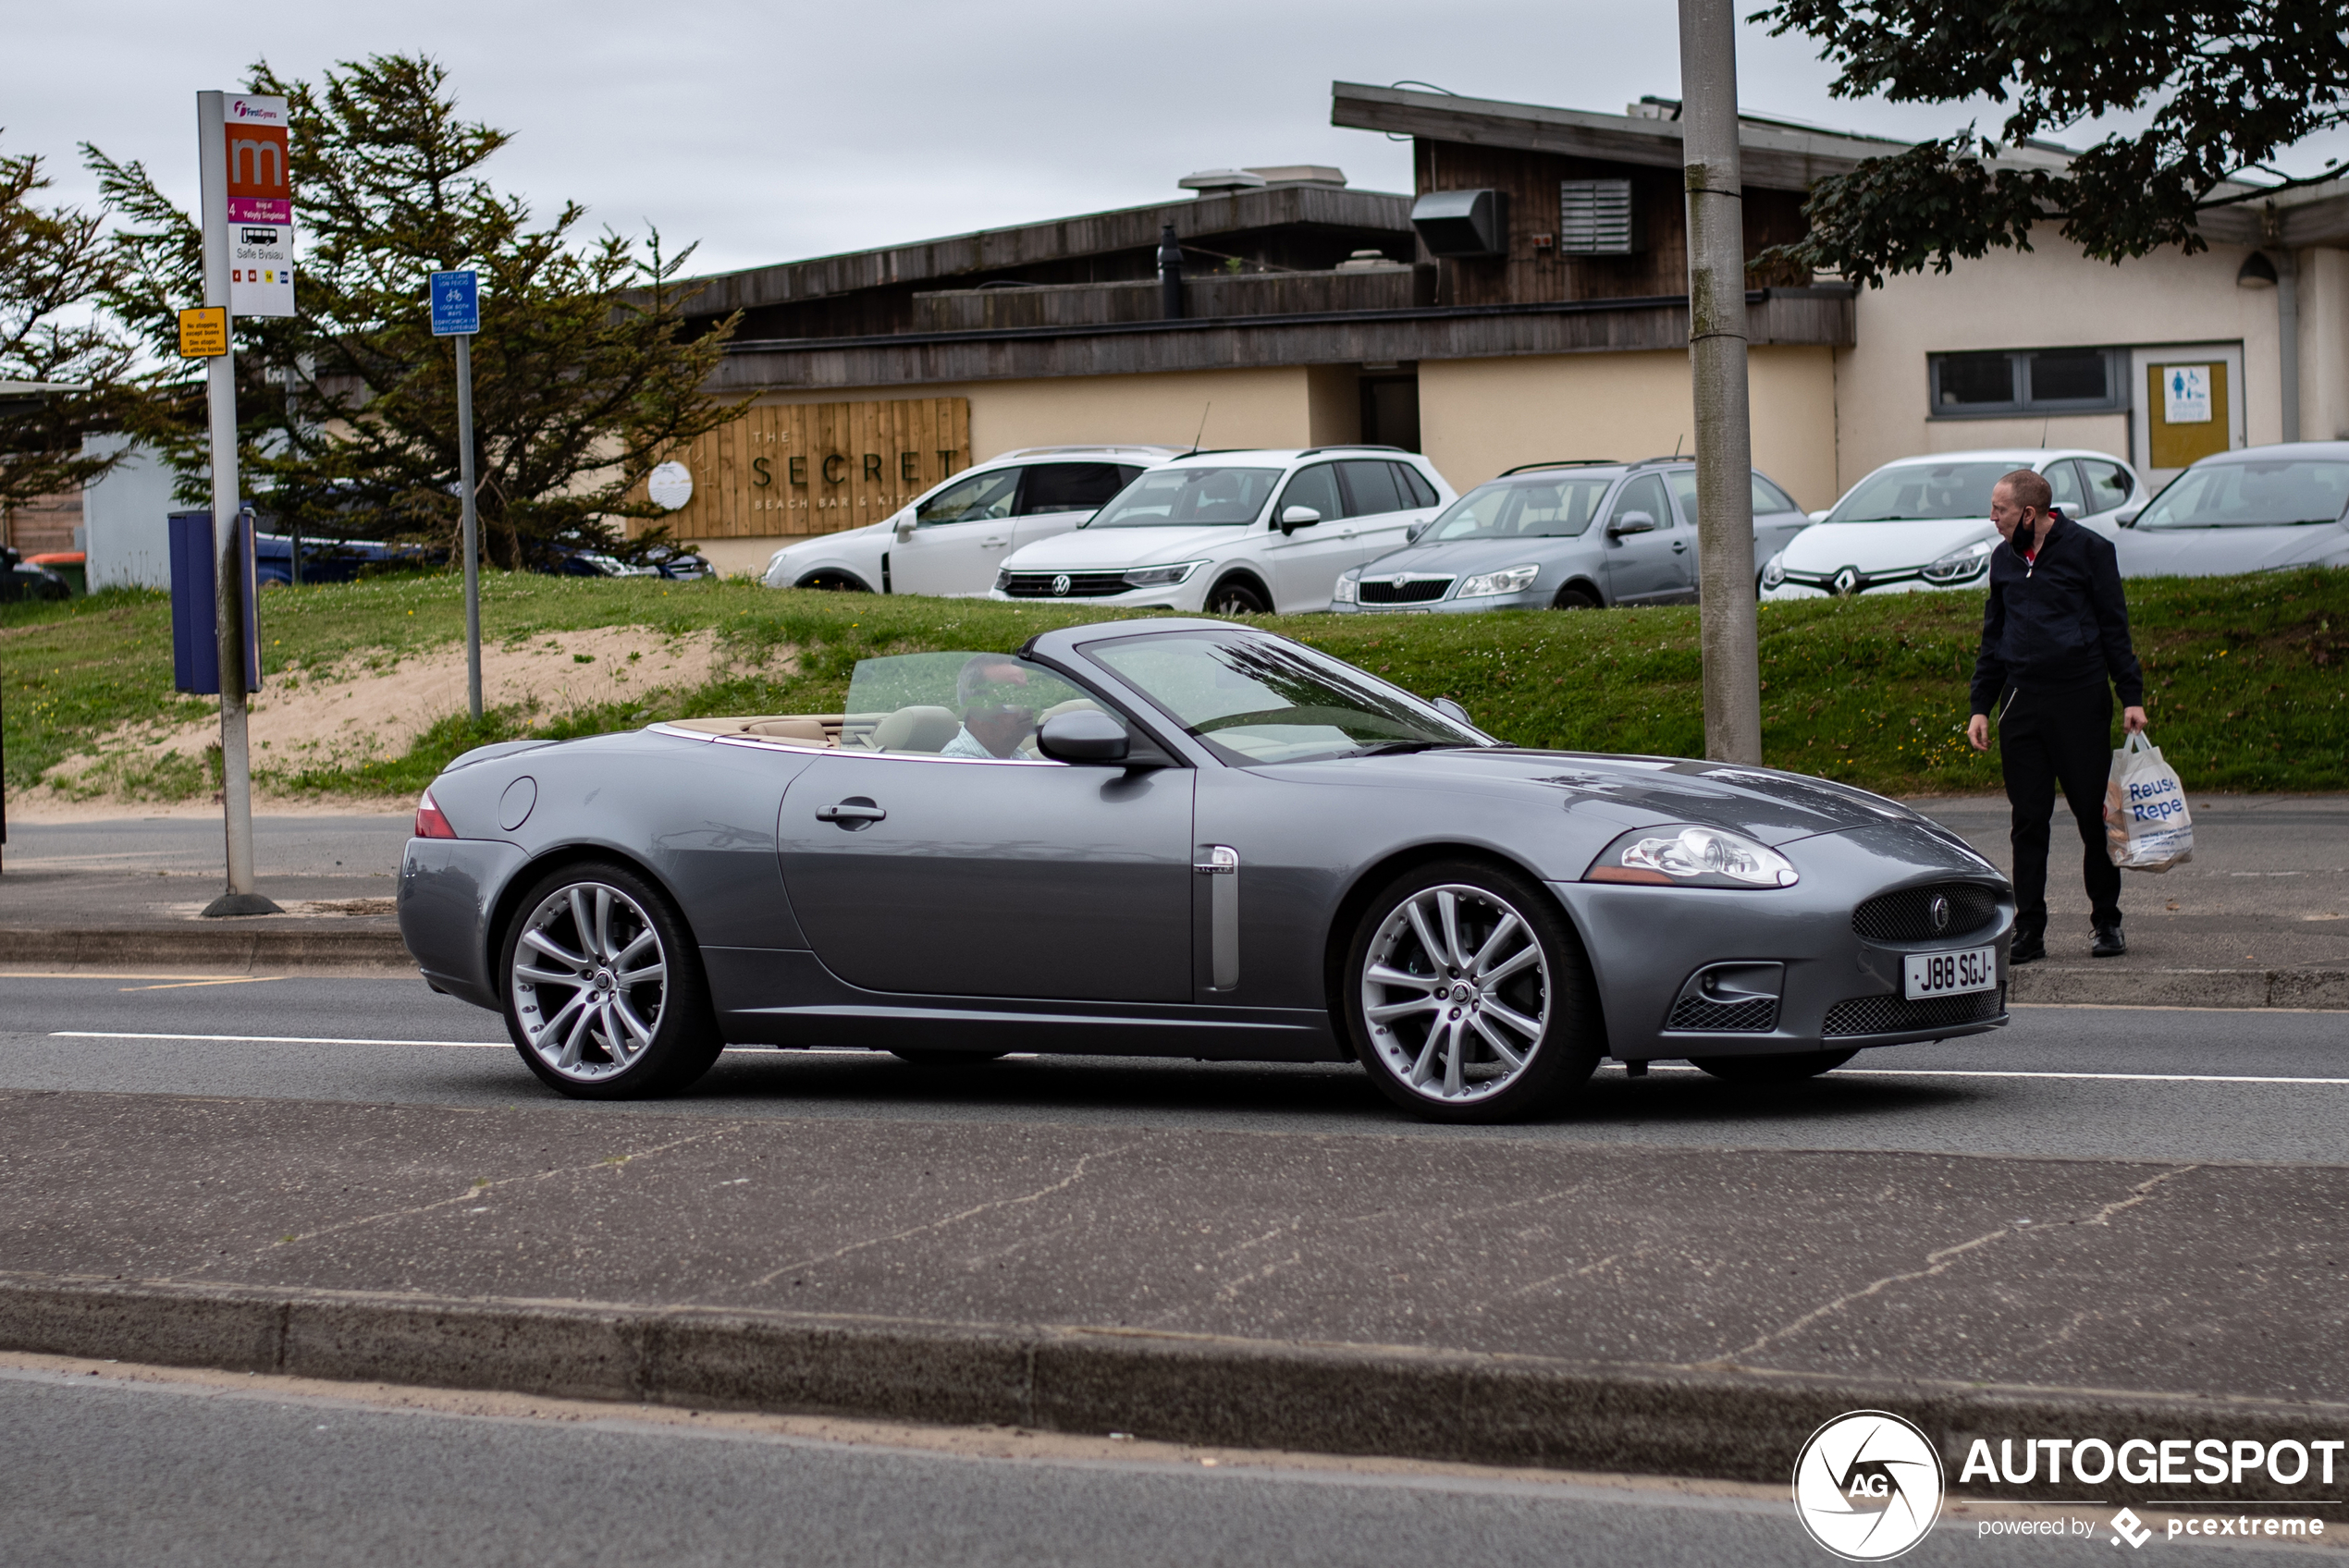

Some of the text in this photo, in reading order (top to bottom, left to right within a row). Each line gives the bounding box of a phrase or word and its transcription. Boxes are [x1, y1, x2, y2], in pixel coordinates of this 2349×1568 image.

[232, 139, 281, 186] m
[228, 202, 236, 216] 4
[237, 248, 284, 261] Safle Bysiau
[753, 432, 790, 443] THE
[753, 449, 958, 486] SECRET
[755, 495, 916, 509] BEACH BAR & KITC
[2133, 798, 2183, 822] Repe
[1921, 951, 1986, 991] J88 SGJ
